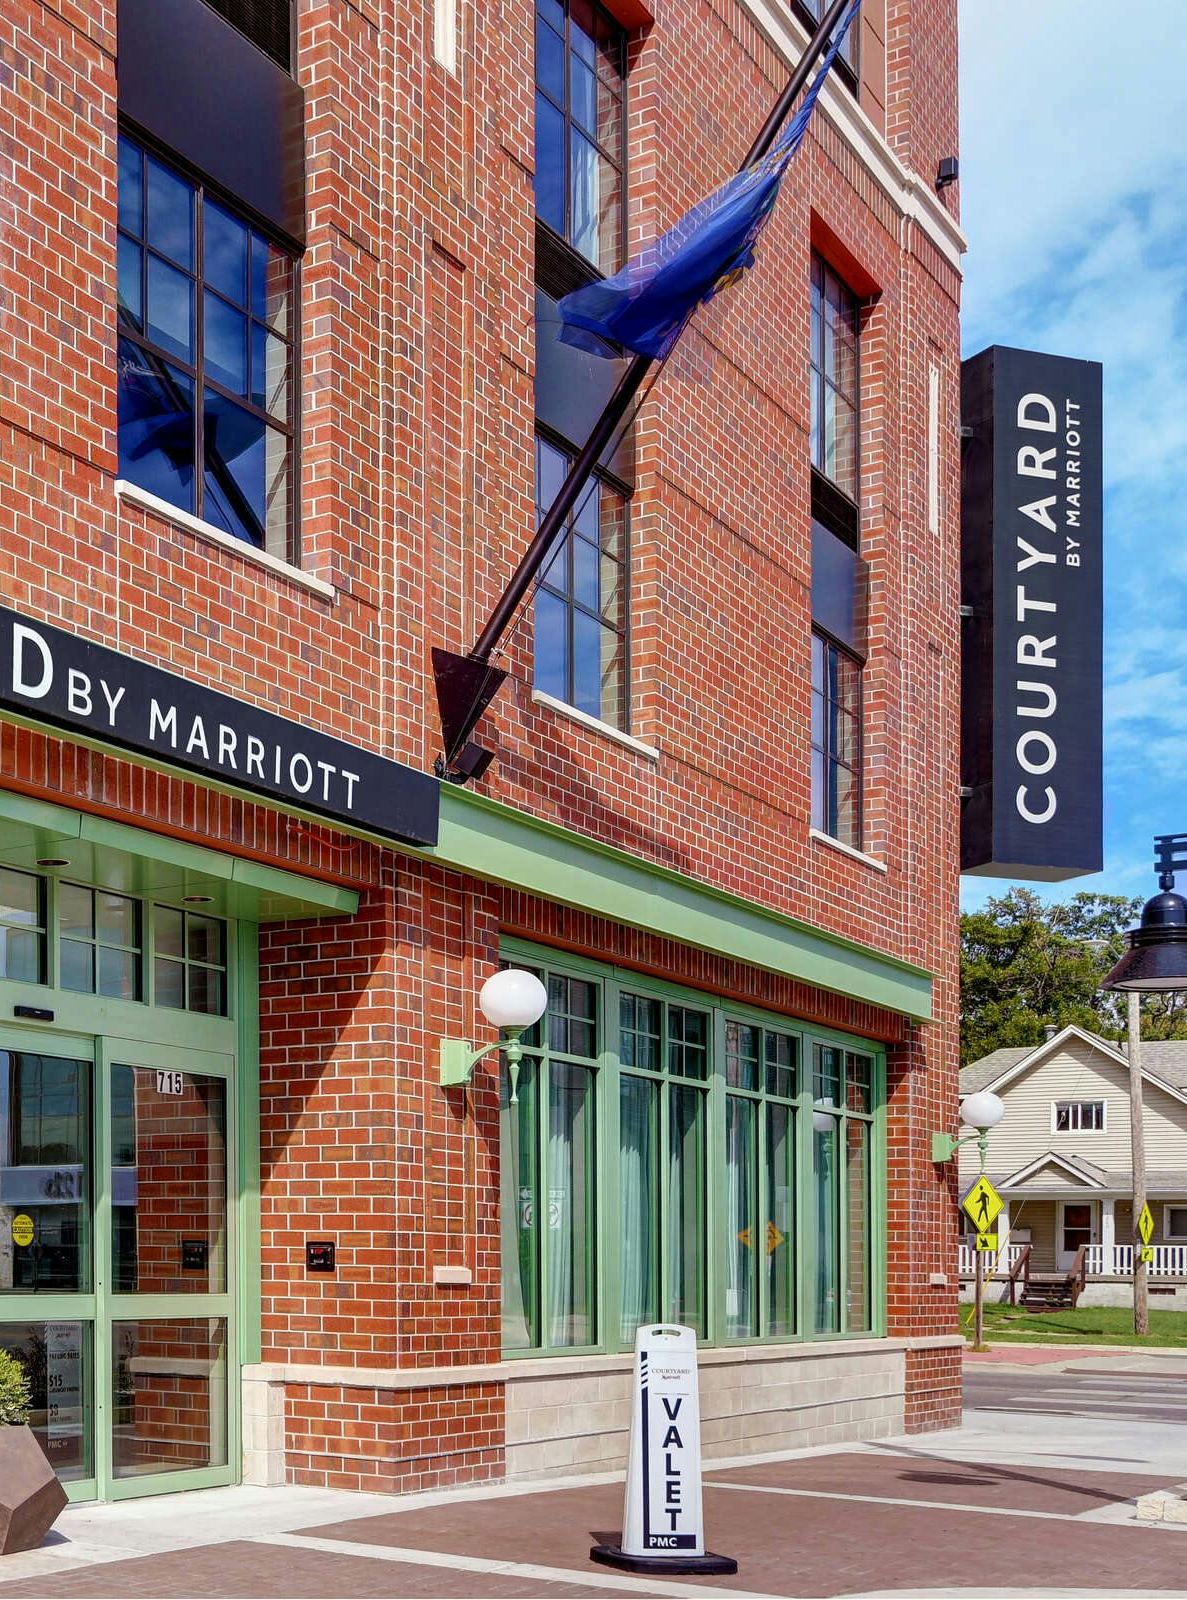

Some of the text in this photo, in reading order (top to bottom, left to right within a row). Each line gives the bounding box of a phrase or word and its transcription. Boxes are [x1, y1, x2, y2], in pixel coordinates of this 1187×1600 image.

[1066, 398, 1081, 567] BY MARRIOTT
[1016, 392, 1057, 824] COURTYARD
[67, 666, 126, 727] BY
[149, 698, 361, 811] MARRIOTT
[158, 1071, 182, 1094] 715
[661, 1397, 684, 1532] VALET
[649, 1536, 678, 1548] PMC
